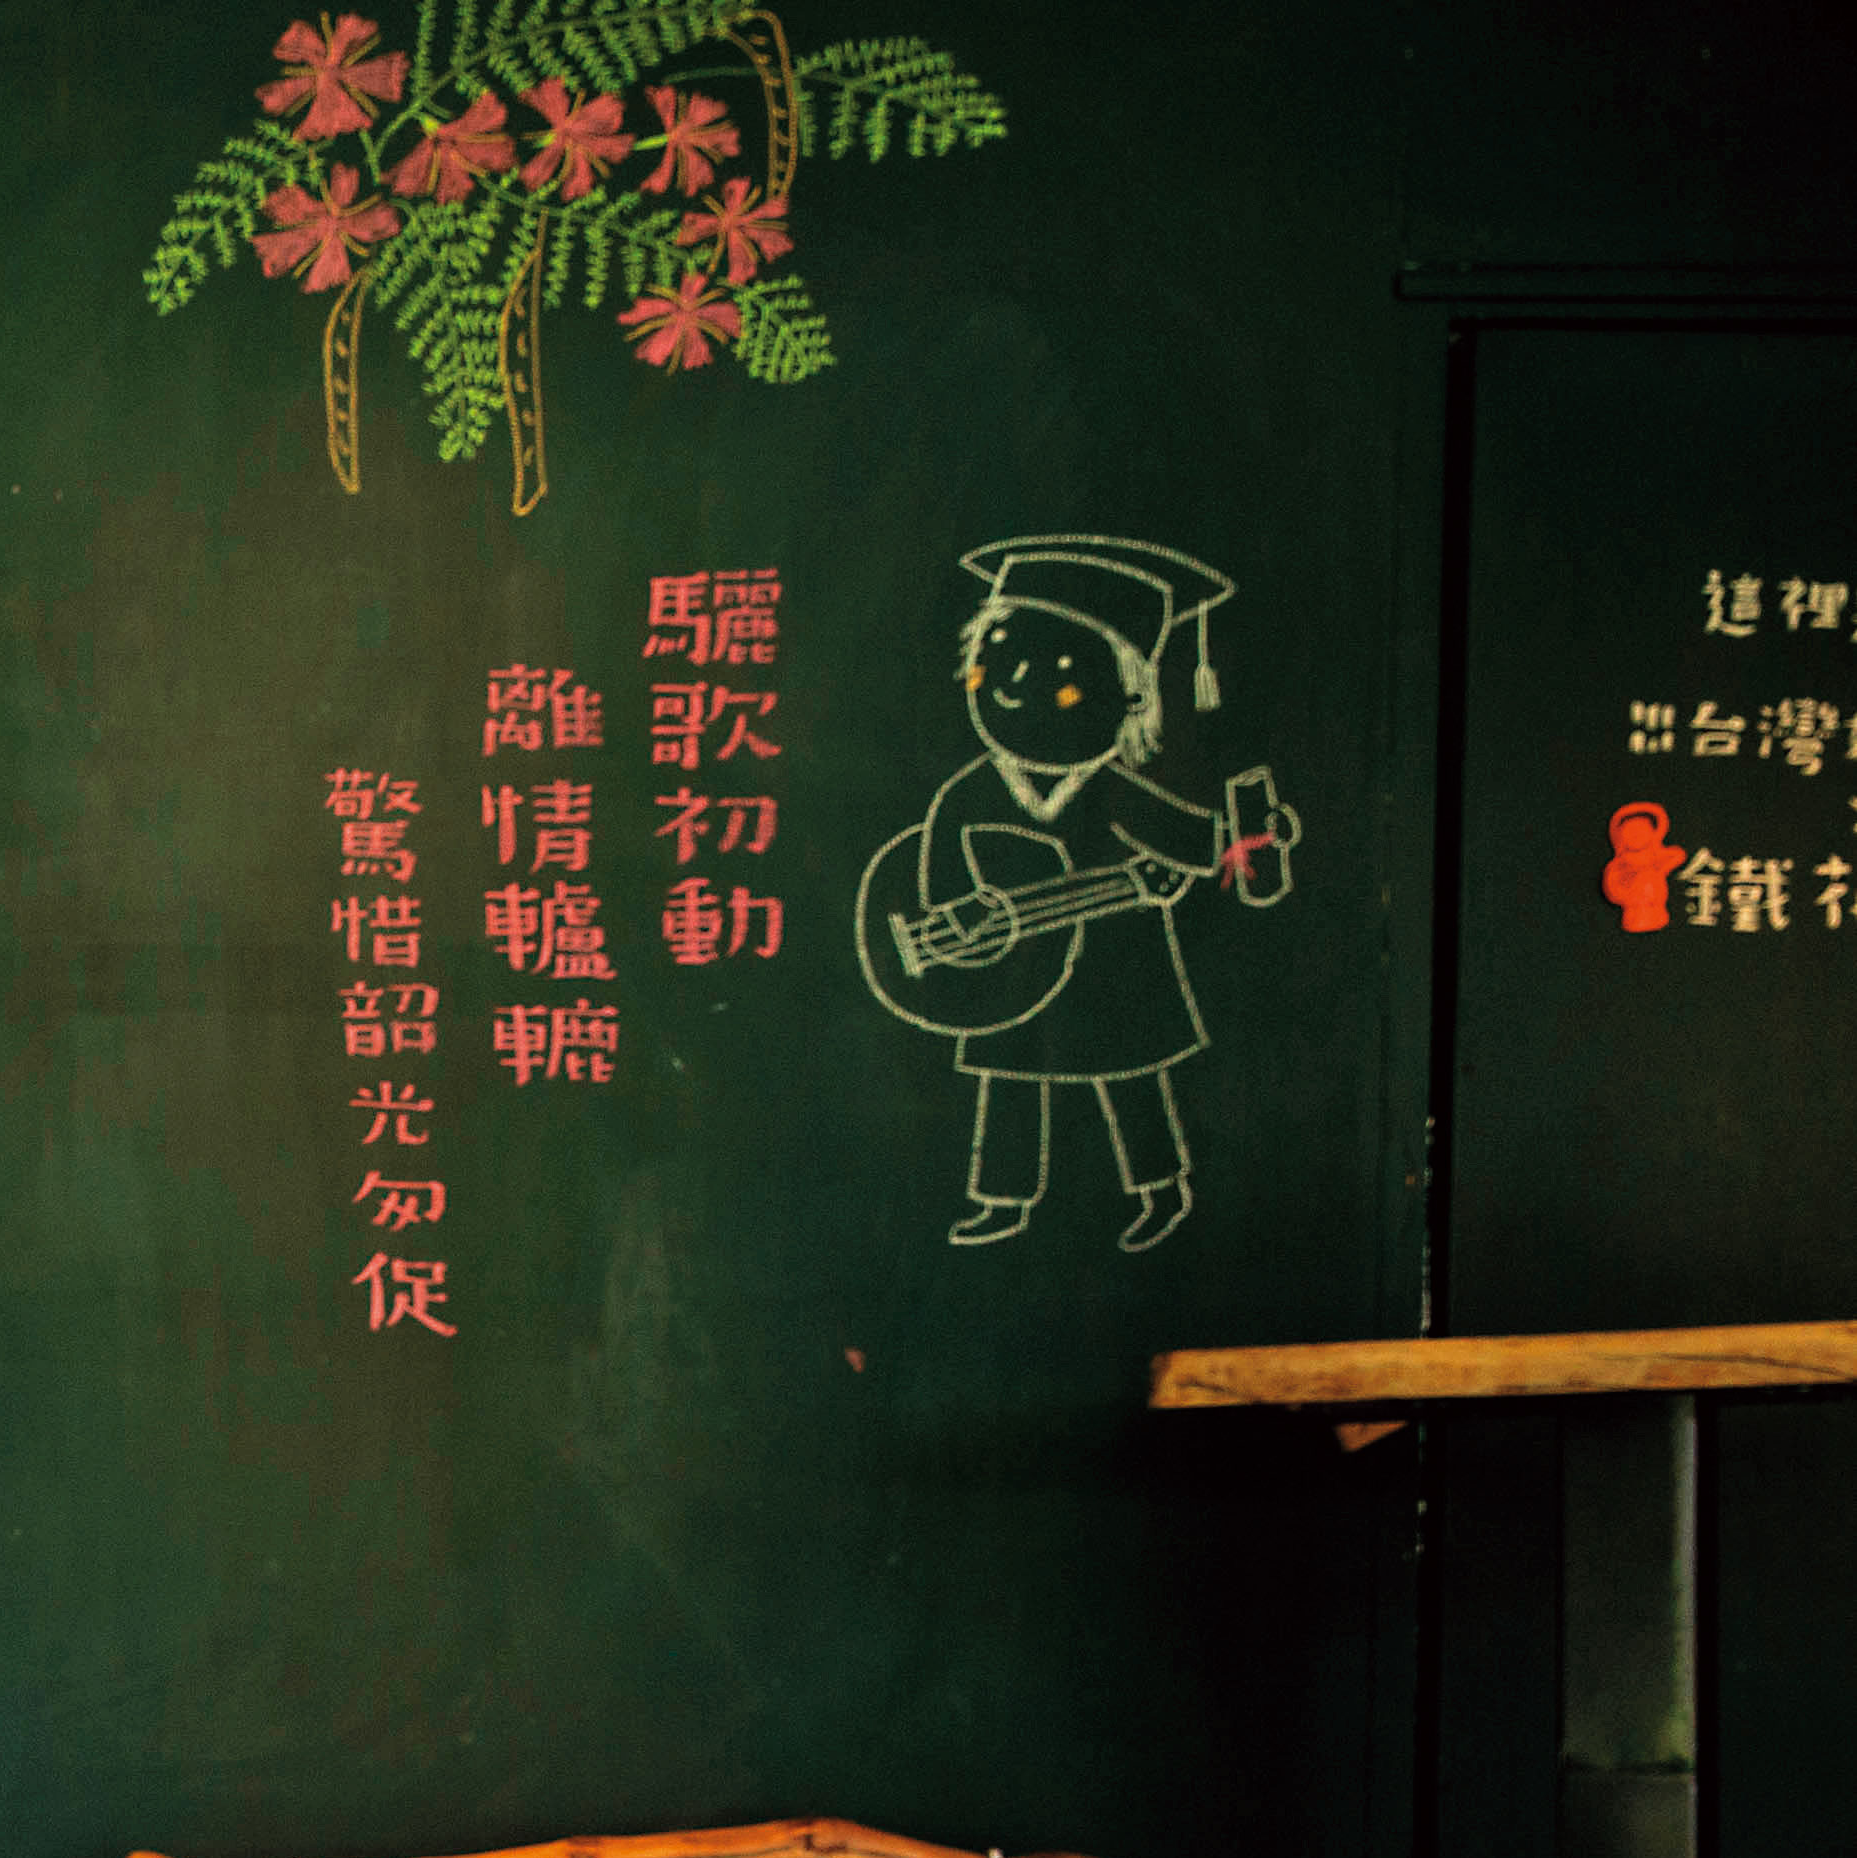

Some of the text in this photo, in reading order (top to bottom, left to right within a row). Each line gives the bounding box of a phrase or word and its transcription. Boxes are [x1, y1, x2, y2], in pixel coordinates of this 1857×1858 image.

[1702, 569, 1857, 642] 這裡
[642, 568, 783, 965] 驪歌初動
[1689, 697, 1857, 776] 台灣
[324, 767, 458, 1337] 驚惜韶光匆促
